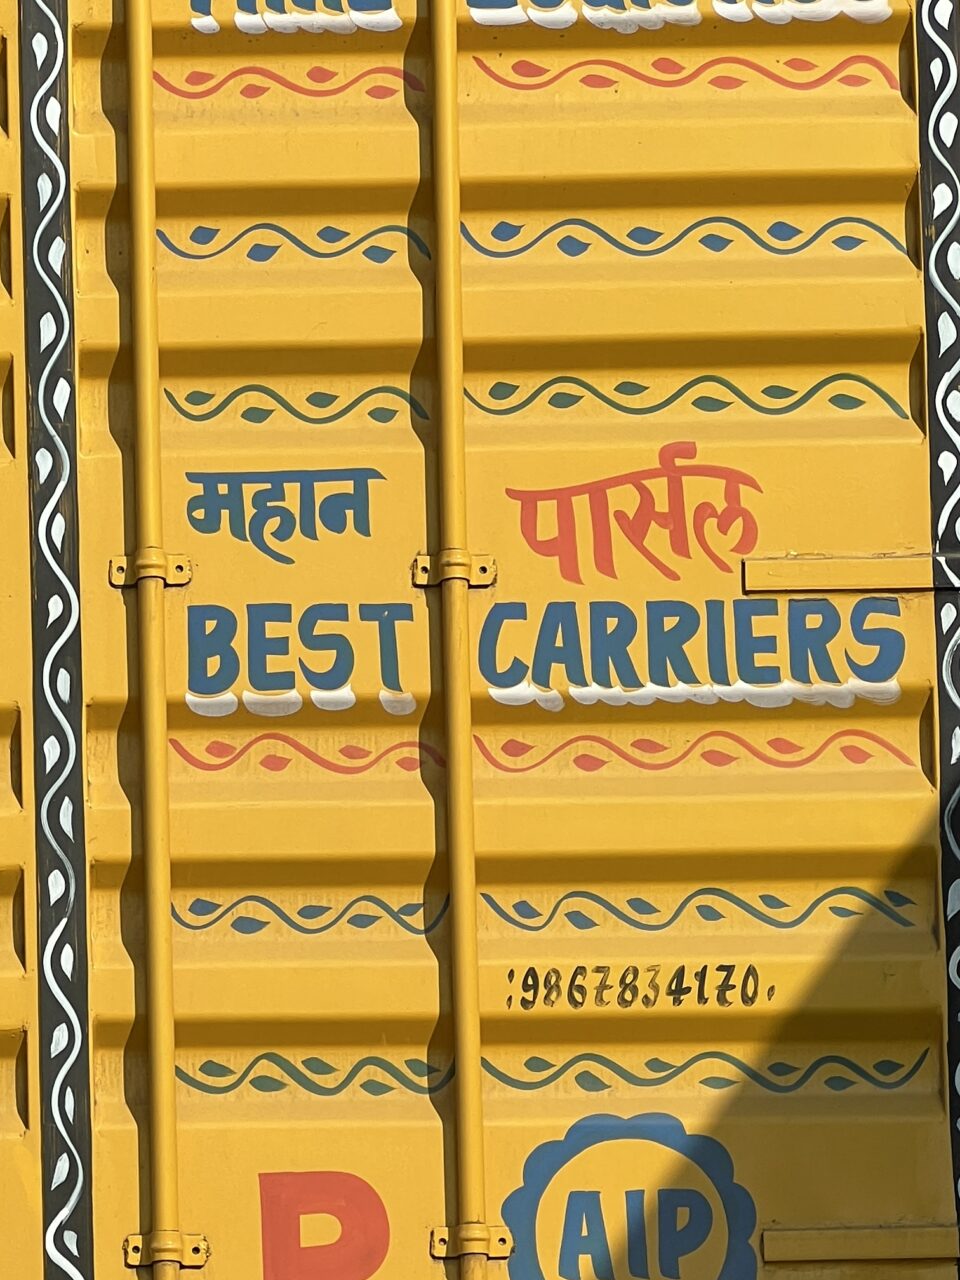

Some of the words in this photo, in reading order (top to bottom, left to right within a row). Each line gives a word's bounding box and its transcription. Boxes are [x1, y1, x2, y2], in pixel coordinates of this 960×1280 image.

[185, 467, 388, 565] महान
[505, 440, 764, 585] पार्सल
[187, 601, 416, 698] BEST
[477, 596, 907, 696] CARRIERS
